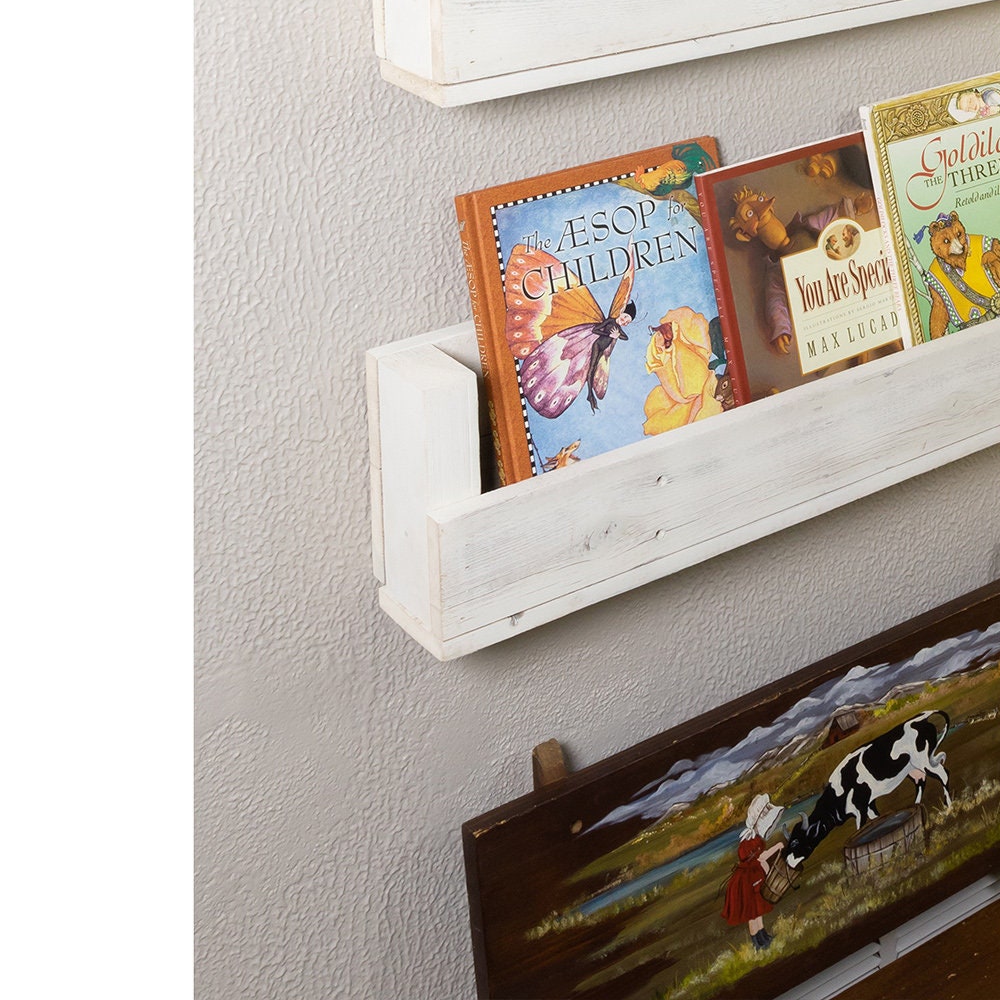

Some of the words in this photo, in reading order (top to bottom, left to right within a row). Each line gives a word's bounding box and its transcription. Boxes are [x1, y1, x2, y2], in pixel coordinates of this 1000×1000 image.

[924, 175, 944, 189] THE
[955, 193, 979, 209] Retold
[979, 187, 993, 202] and
[523, 230, 552, 256] The
[555, 198, 656, 252] ÆSOP
[667, 195, 687, 222] for
[878, 196, 888, 236] GOLDILOCKS
[890, 268, 898, 290] THREE
[894, 292, 902, 311] BEARS
[520, 225, 699, 301] CHILDREN
[698, 192, 706, 216] YOU
[710, 261, 724, 318] SPECIAL
[724, 337, 733, 365] MAX
[795, 271, 824, 313] You
[825, 267, 848, 301] Are
[462, 240, 470, 256] The
[466, 260, 478, 298] ÆSOP
[474, 314, 488, 376] CHILDREN
[807, 331, 841, 358] MAX
[848, 310, 899, 343] LUCAD
